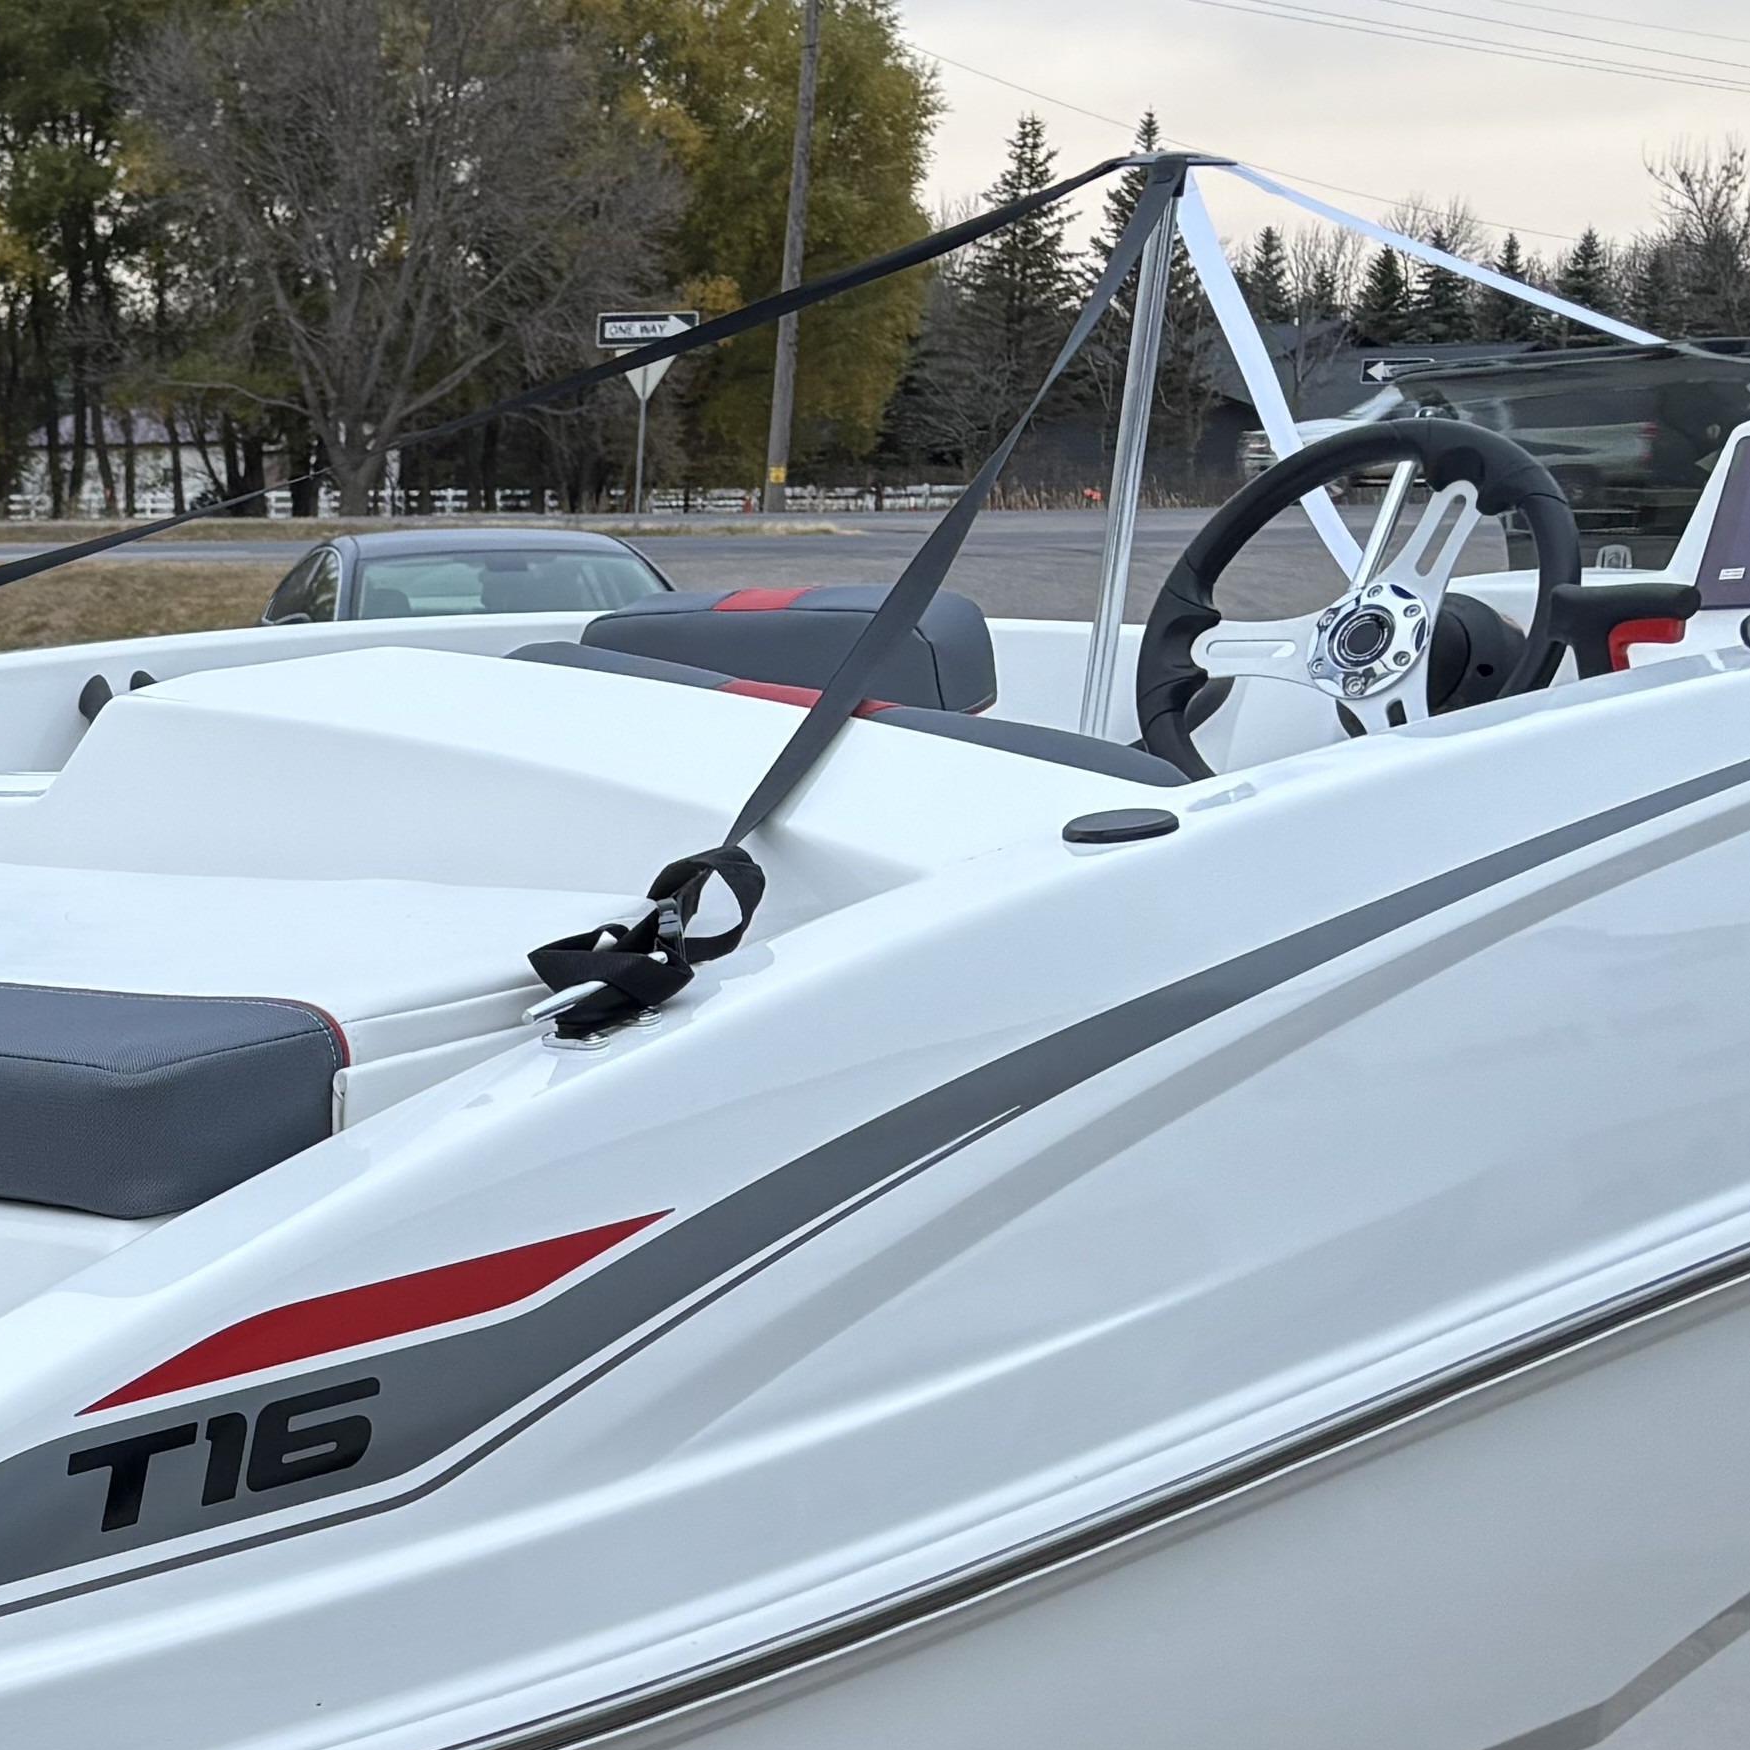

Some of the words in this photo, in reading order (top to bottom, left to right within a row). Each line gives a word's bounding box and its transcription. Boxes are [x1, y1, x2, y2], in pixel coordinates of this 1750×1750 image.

[609, 324, 633, 336] ONE
[640, 324, 666, 335] WAY
[67, 1376, 381, 1533] T16
